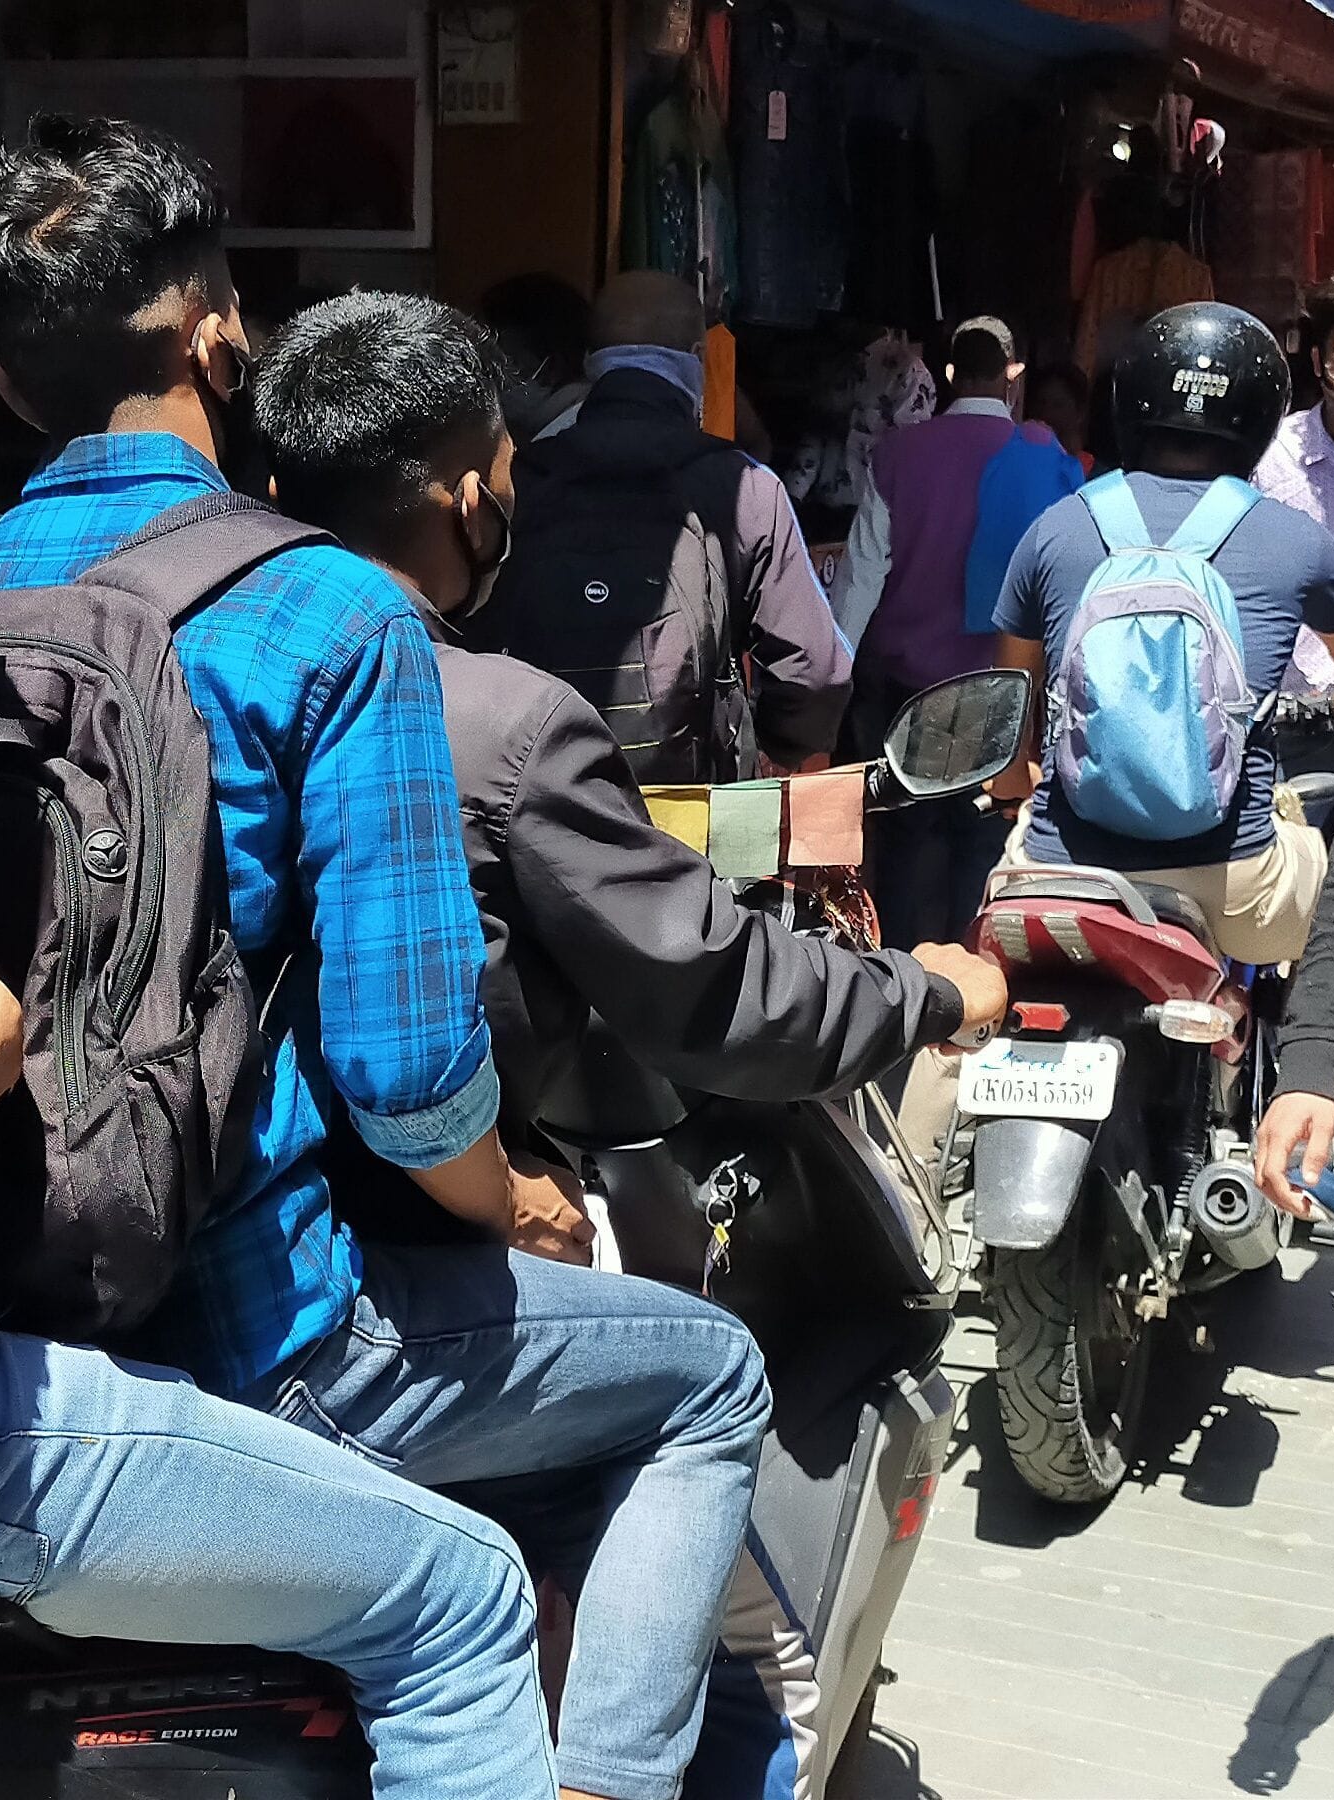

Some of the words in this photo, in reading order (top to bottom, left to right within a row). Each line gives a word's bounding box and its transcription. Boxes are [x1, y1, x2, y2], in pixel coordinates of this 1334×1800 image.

[1172, 369, 1230, 398] STUDDS
[587, 587, 606, 596] DELL
[77, 1729, 156, 1746] RACE
[161, 1728, 239, 1740] EDITION
